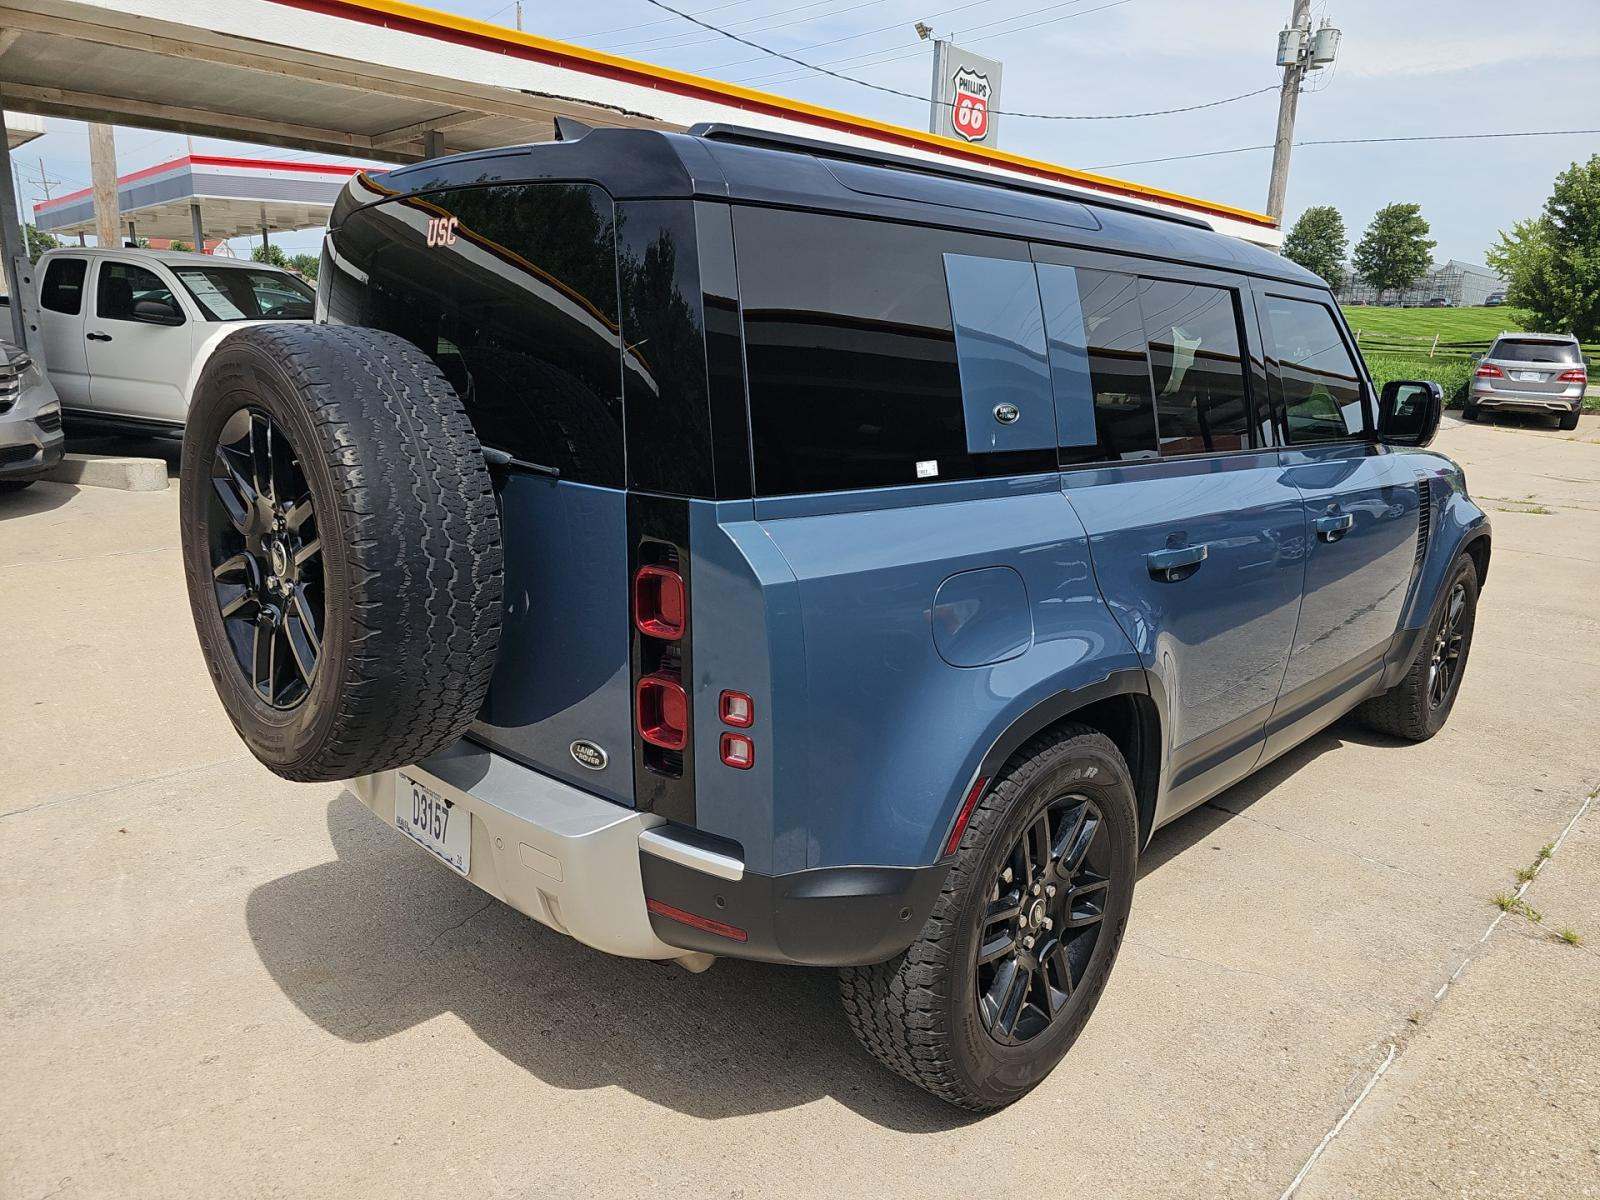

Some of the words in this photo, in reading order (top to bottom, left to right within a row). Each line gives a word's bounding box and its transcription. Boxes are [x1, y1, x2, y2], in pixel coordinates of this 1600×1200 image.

[959, 77, 987, 98] PHILLIPS
[958, 99, 984, 130] 66
[426, 216, 459, 249] USC
[576, 744, 594, 757] LAND
[578, 753, 600, 766] ROVER
[412, 788, 450, 845] D3157
